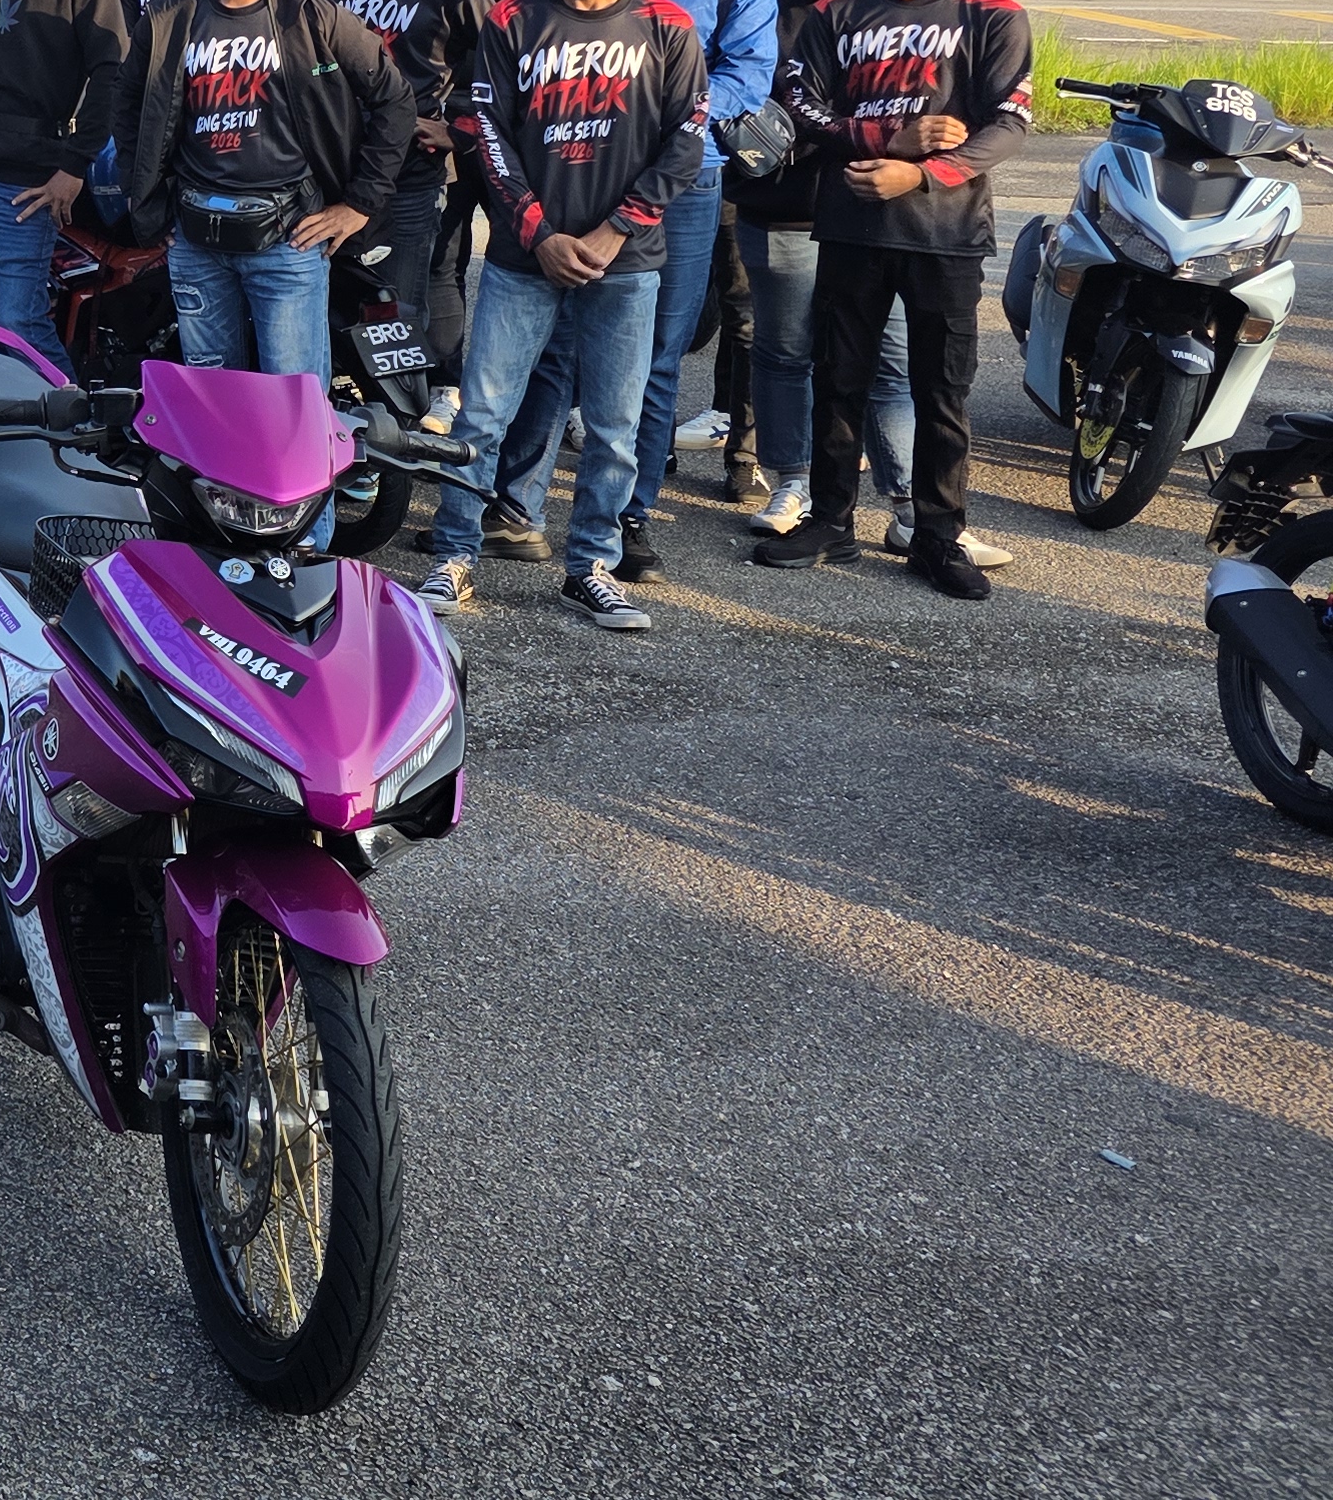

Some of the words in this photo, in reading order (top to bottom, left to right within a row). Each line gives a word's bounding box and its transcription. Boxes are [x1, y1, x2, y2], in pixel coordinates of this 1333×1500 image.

[186, 36, 281, 77] AMERON
[837, 23, 964, 69] CAMERON
[517, 40, 647, 92] CAMERON
[845, 56, 941, 98] ATTACK
[527, 74, 630, 122] ATTACK
[1211, 83, 1255, 107] TCS
[1205, 97, 1257, 122] 8158
[209, 131, 242, 149] 2026
[574, 118, 613, 142] SETIU
[488, 138, 510, 178] RIDER
[559, 142, 595, 159] 2026
[366, 321, 410, 346] BRQ
[372, 346, 427, 371] 5765
[1171, 349, 1210, 369] YAMAHA
[233, 647, 294, 689] 9464
